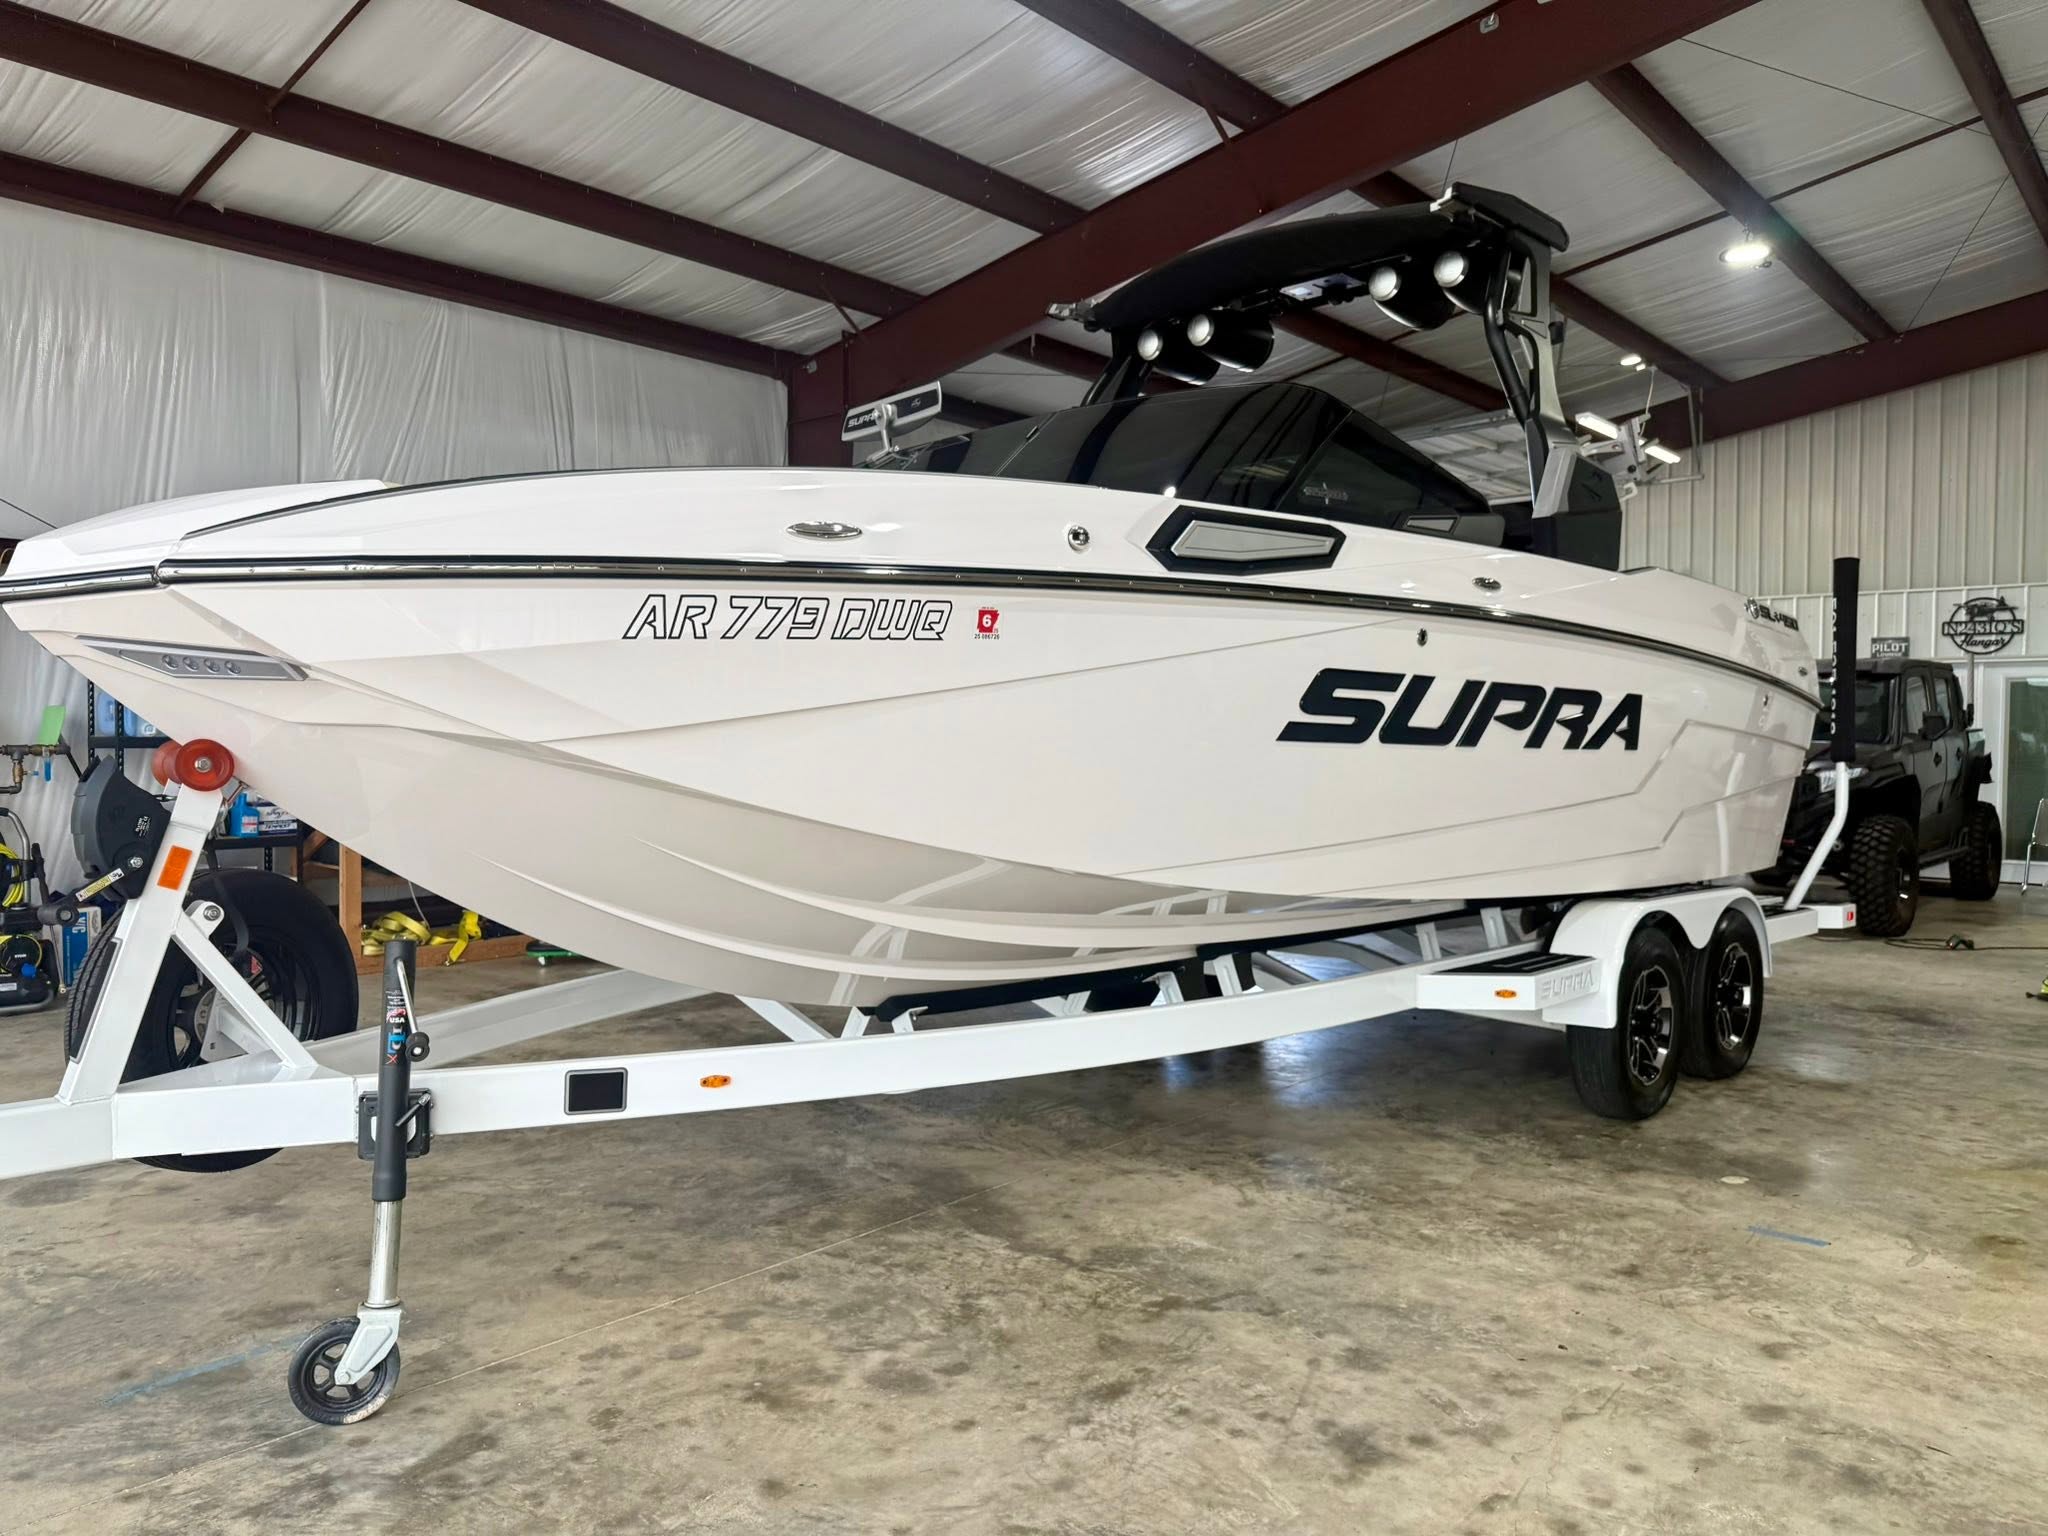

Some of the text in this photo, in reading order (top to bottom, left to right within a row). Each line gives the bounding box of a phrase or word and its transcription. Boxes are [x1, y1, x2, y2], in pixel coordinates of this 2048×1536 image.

[622, 594, 953, 641] AR 779 DWQ
[982, 614, 992, 628] 6
[1872, 642, 1909, 654] PILOT
[1959, 635, 2006, 649] Hangar
[1276, 667, 1643, 751] SUPRA
[1541, 969, 1595, 999] SUPRA
